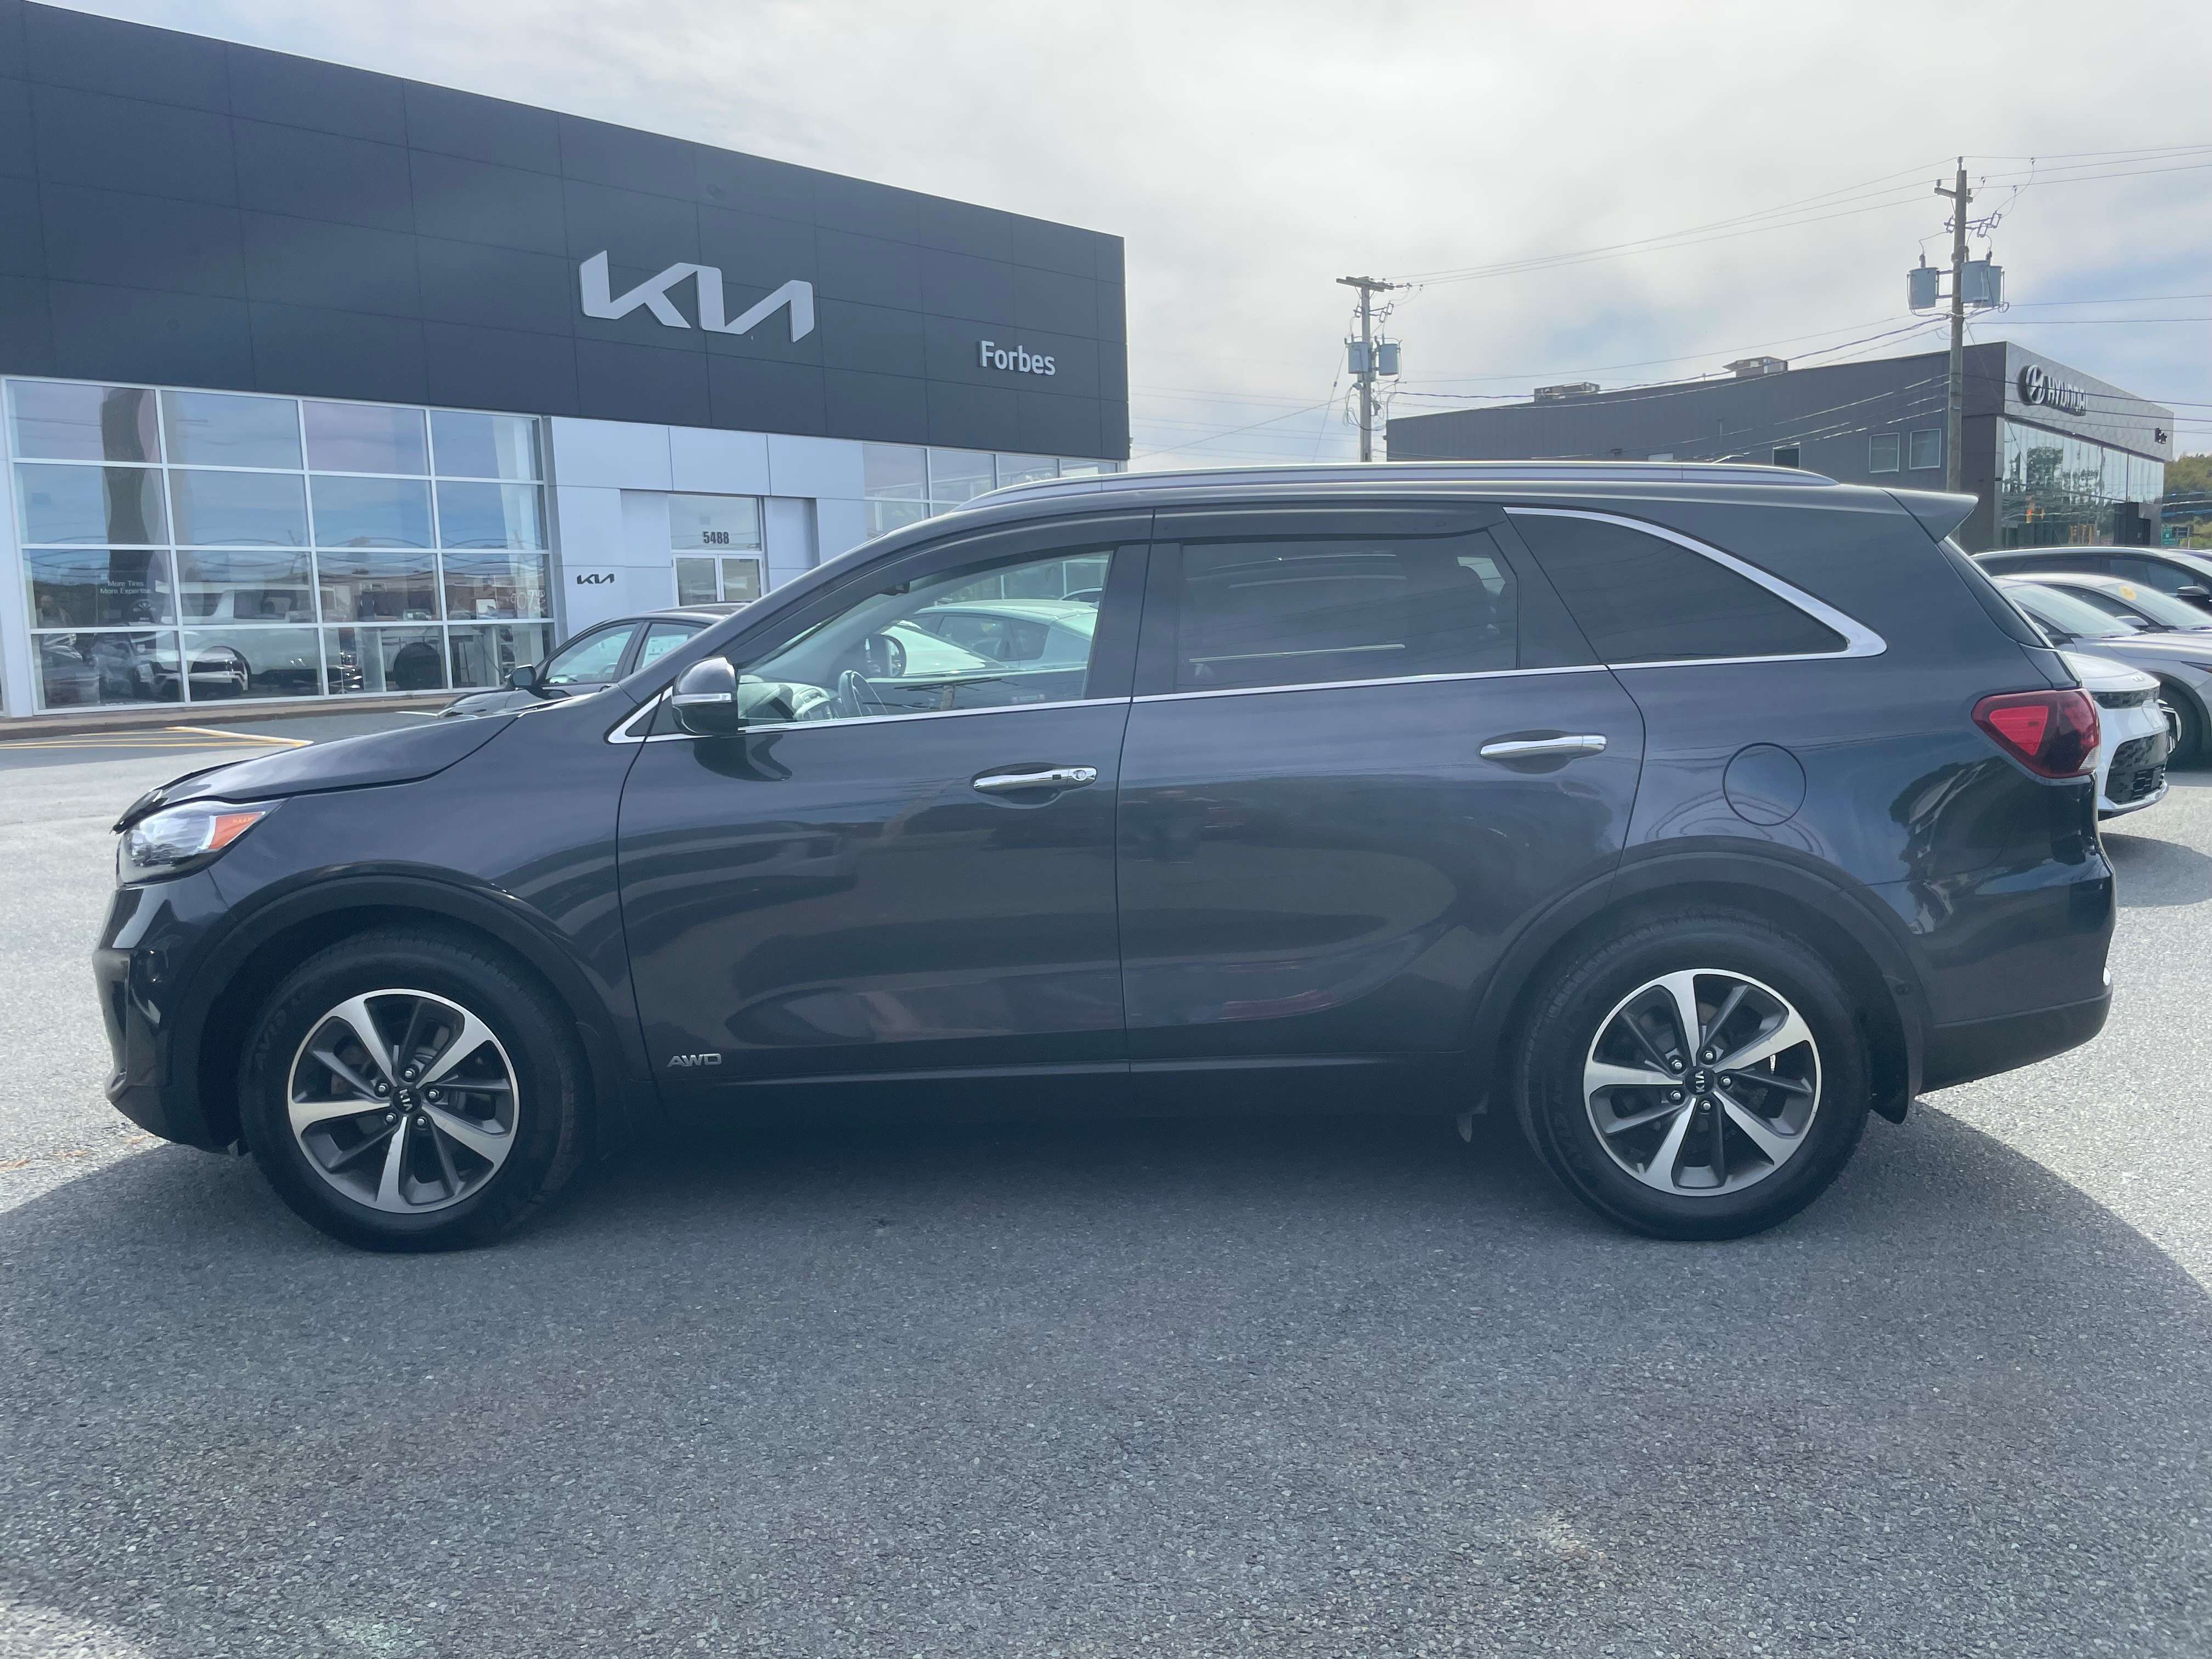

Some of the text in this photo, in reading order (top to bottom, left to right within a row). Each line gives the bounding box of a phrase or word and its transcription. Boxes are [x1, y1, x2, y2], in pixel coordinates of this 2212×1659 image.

[579, 250, 815, 343] KIA
[980, 340, 1056, 376] Forbes
[703, 531, 729, 544] 5488
[577, 573, 614, 584] KIA
[667, 1053, 722, 1067] AWD
[1695, 1070, 1705, 1093] KIA
[399, 1089, 413, 1111] KIA
